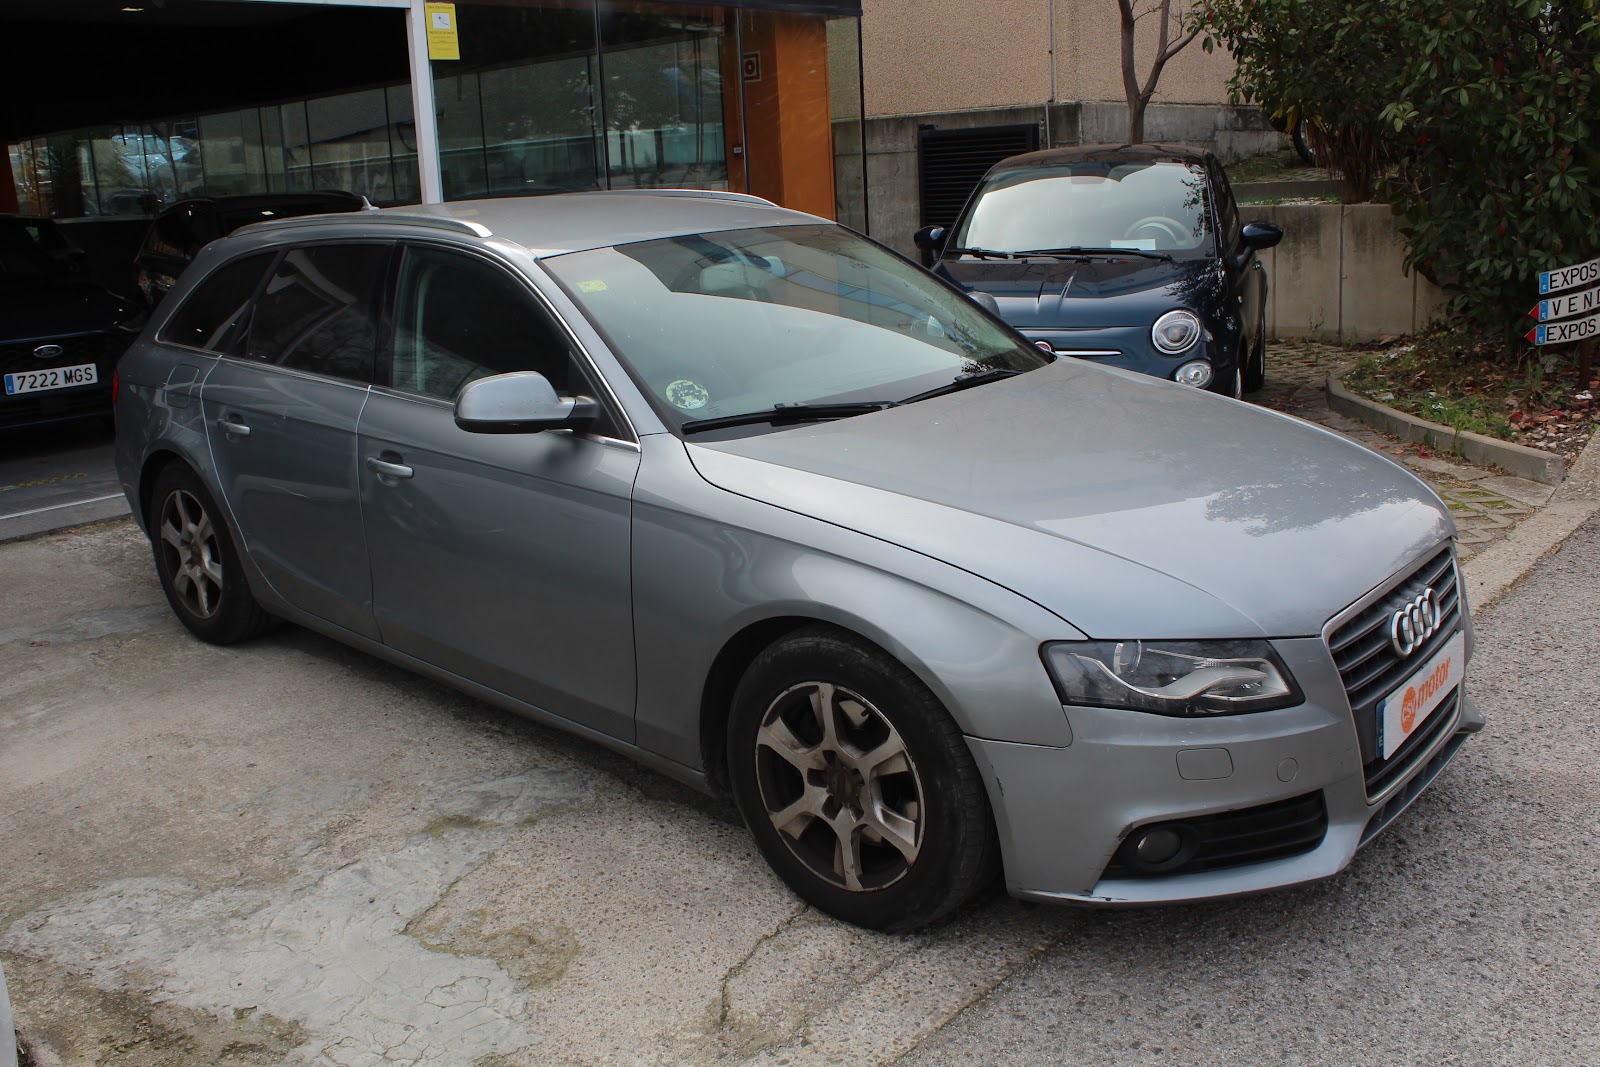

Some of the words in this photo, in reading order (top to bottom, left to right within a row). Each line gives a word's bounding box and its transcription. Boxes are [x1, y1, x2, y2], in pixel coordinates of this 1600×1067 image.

[17, 372, 59, 391] 7222
[63, 367, 93, 384] MGS
[1417, 656, 1452, 710] motor
